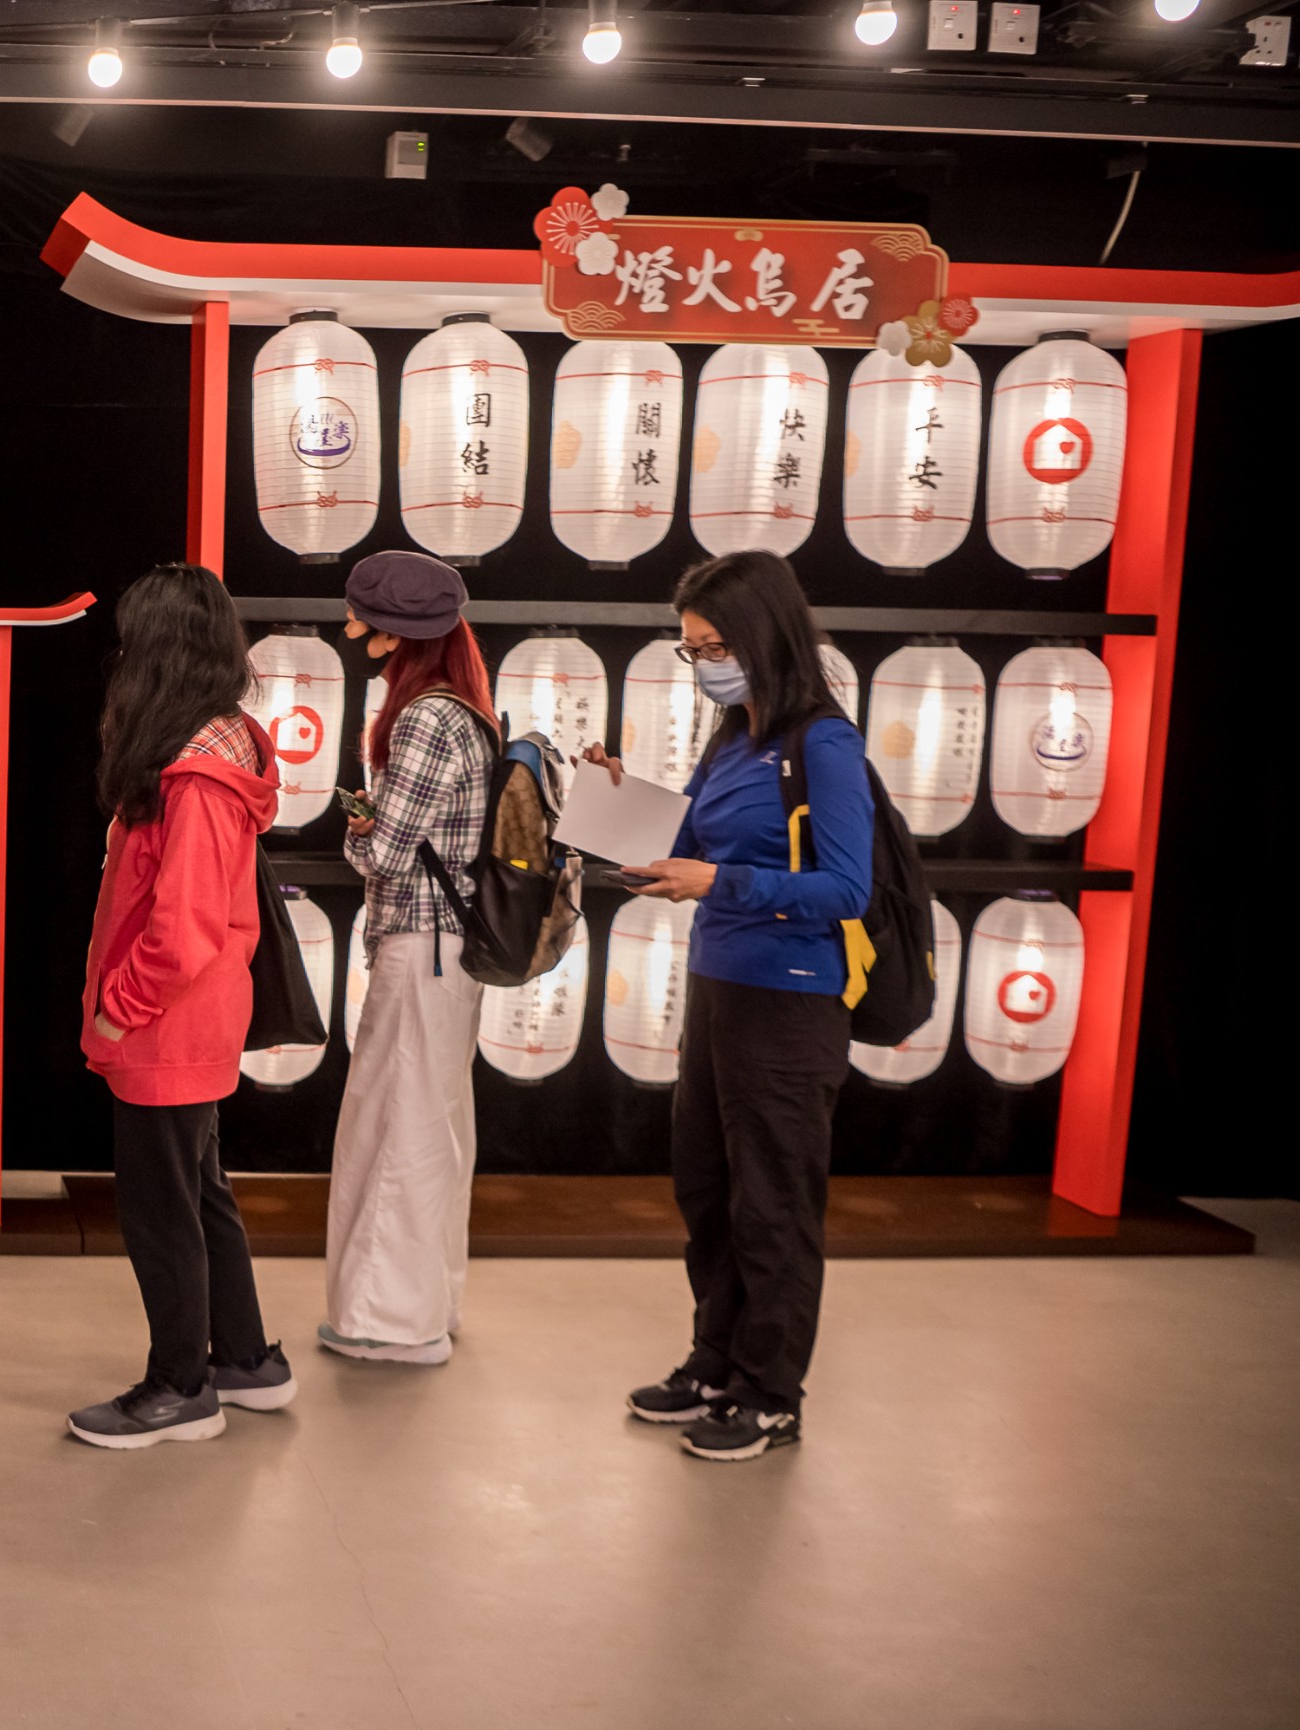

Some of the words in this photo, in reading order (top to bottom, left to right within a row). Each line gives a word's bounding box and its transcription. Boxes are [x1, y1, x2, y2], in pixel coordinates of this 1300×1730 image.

[461, 393, 491, 476] 團結
[632, 402, 662, 486] 關懷
[774, 408, 806, 489] 快樂
[908, 406, 944, 490] 平安
